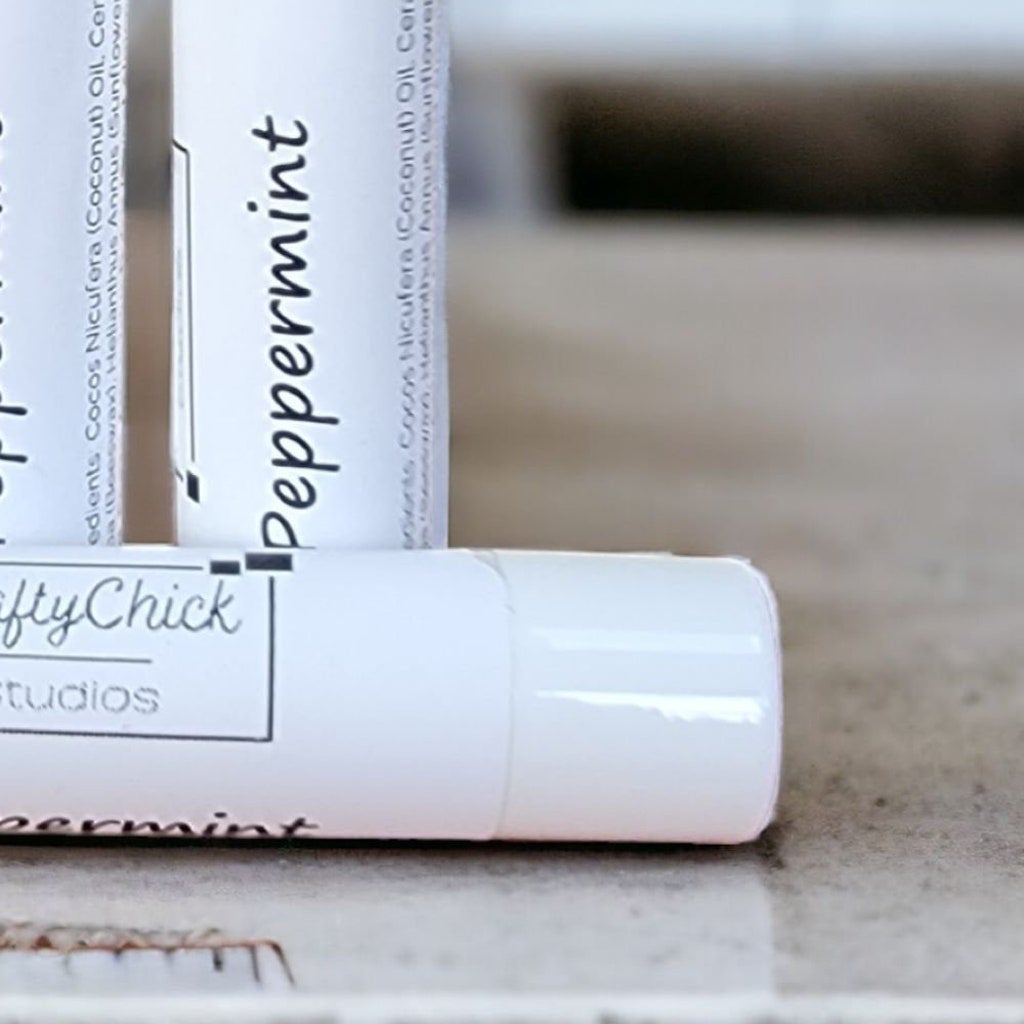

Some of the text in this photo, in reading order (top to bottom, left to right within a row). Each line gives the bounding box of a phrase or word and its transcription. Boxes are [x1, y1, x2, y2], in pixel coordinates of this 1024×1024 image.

[85, 105, 105, 235] (Coconut)
[84, 241, 102, 353] Nicufera
[246, 114, 340, 550] Peppermint
[84, 359, 101, 441] Cocos
